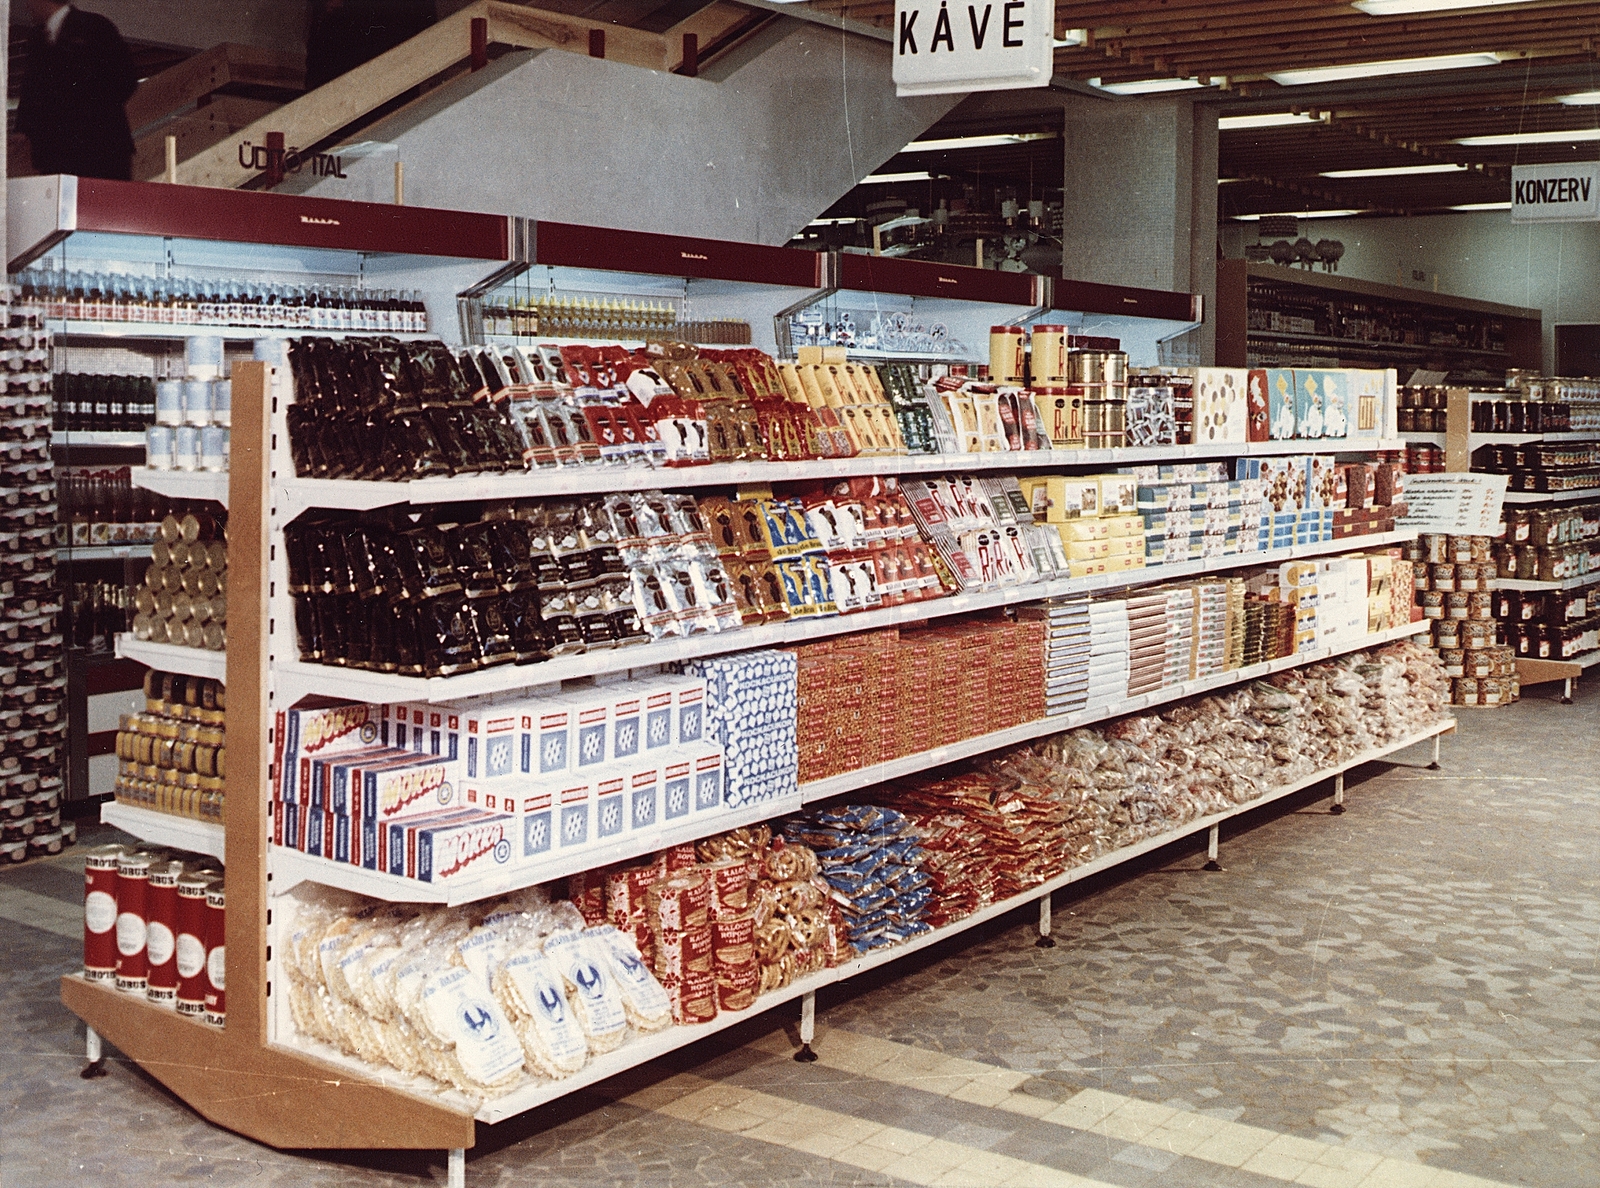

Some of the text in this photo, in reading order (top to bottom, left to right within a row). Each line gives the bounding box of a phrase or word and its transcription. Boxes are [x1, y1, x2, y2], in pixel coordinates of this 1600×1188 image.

[899, 0, 1025, 55] KÁVÉ
[312, 153, 347, 179] ITAL
[1515, 177, 1591, 205] KONZERV
[382, 765, 446, 817] MOKKA
[438, 823, 504, 878] MOKKA
